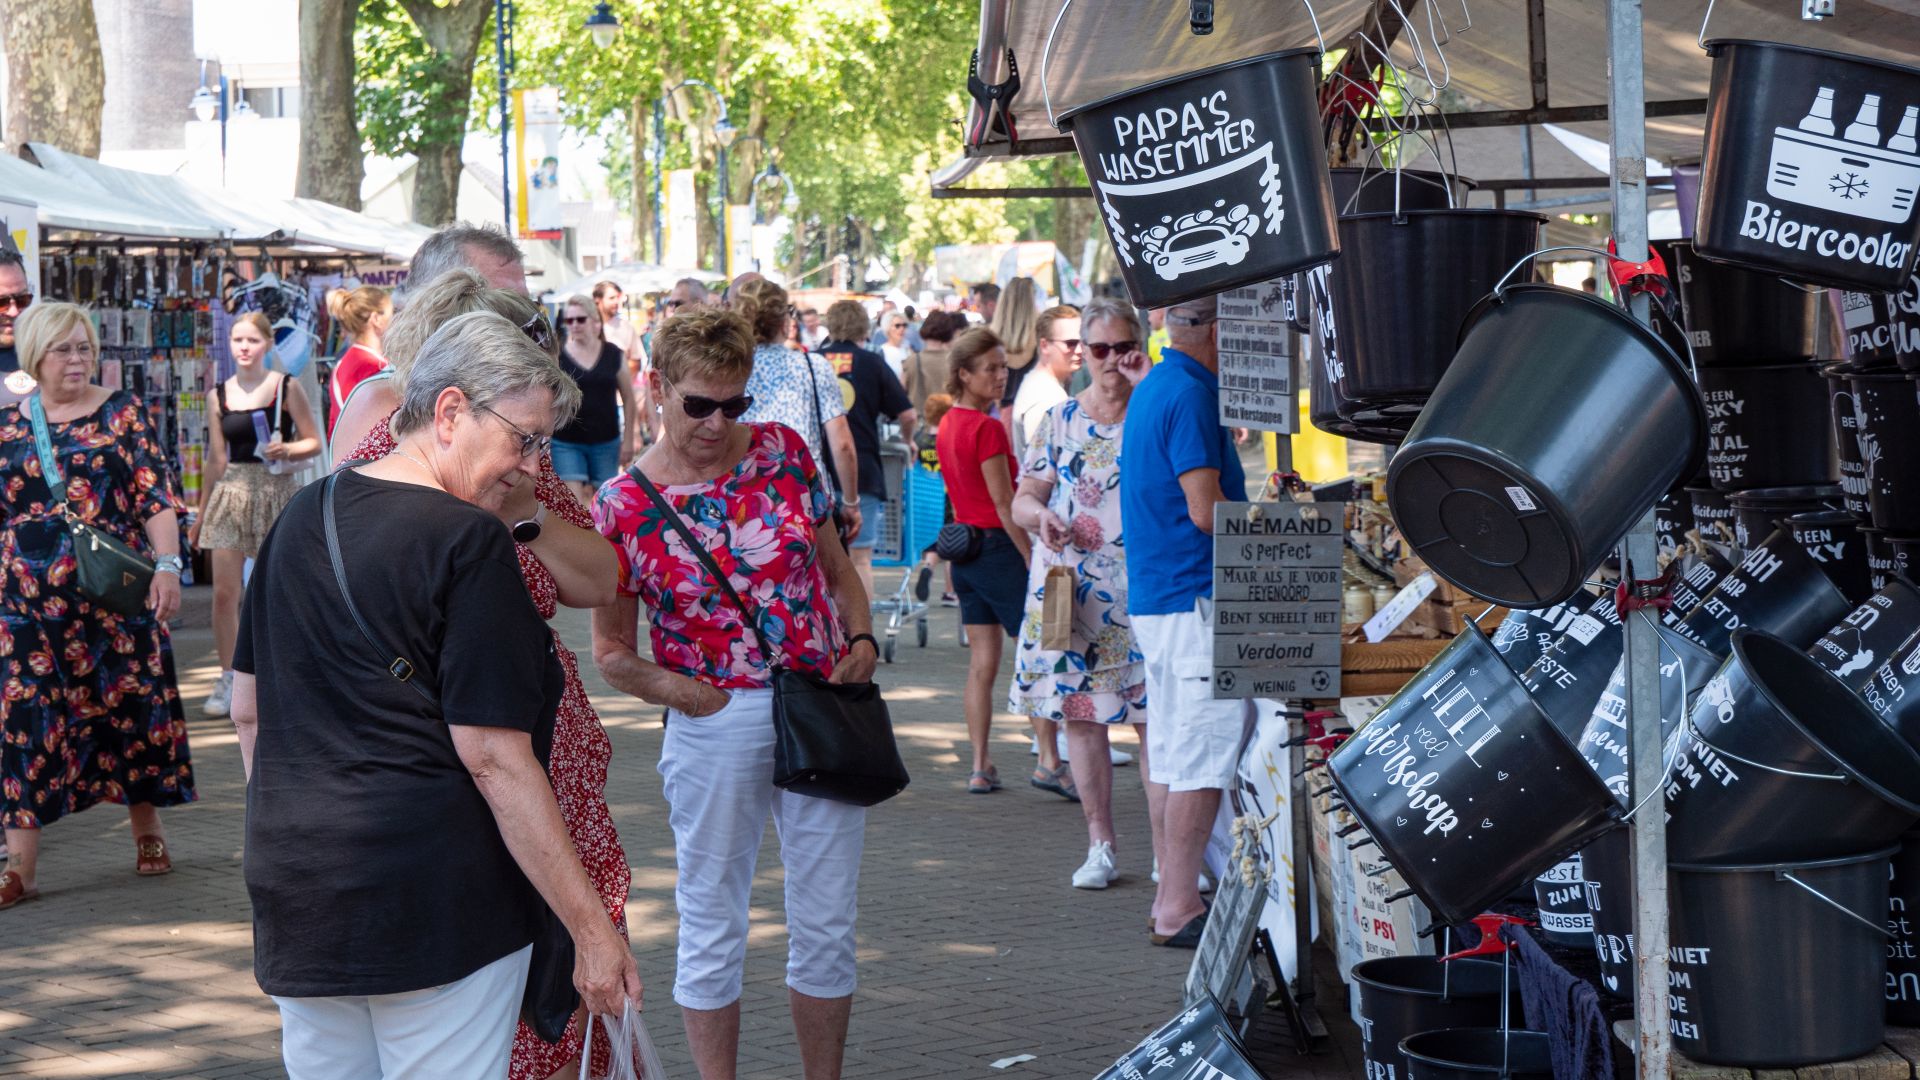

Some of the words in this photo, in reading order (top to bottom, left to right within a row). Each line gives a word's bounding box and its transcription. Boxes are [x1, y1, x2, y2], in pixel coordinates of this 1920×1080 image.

[1114, 90, 1230, 147] PAPA'S
[1099, 118, 1256, 181] WASEMMER
[1739, 200, 1912, 269] Biercooler
[1224, 405, 1239, 419] Max
[1240, 408, 1283, 424] Verstappen
[1723, 435, 1749, 450] AL
[1225, 518, 1332, 534] NIEMAND
[1804, 529, 1832, 543] EEN
[1248, 585, 1310, 601] FEYENOORD
[1704, 596, 1732, 619] ZET
[1237, 643, 1315, 660] Verdomd
[1253, 680, 1296, 693] WEINIG
[1422, 669, 1502, 768] HEEL
[1414, 721, 1449, 758] veel
[1358, 709, 1459, 838] beterschap
[1692, 740, 1740, 787] NIET
[1547, 884, 1582, 907] ZIJN
[1668, 947, 1710, 965] NIET
